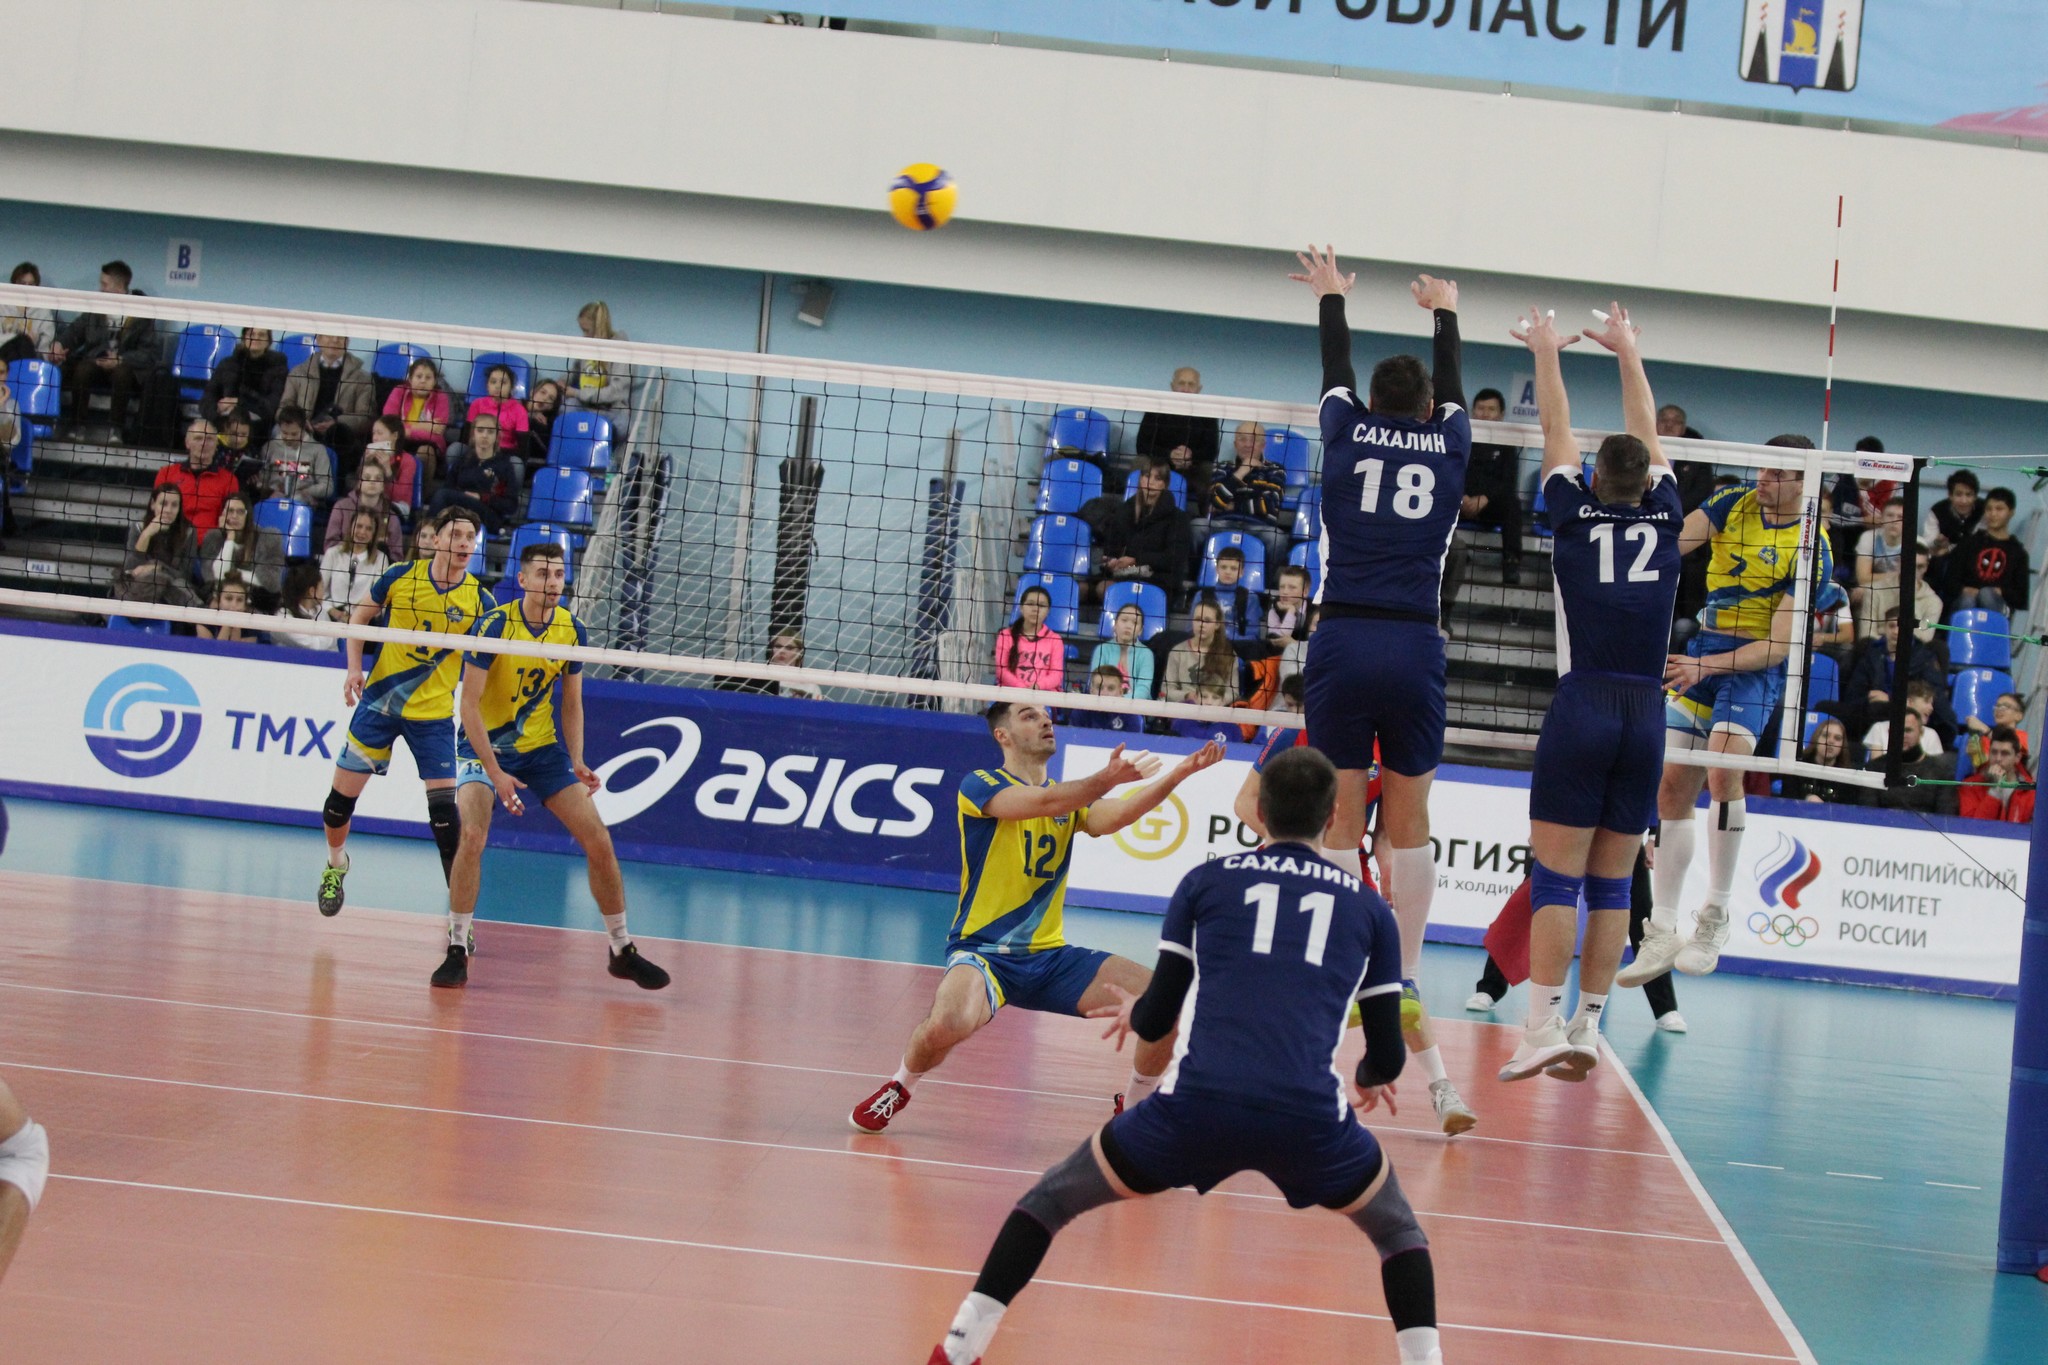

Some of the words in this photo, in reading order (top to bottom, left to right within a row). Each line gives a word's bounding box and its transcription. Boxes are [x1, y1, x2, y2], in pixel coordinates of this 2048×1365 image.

[1352, 423, 1447, 454] САХАЛИН
[1353, 457, 1436, 519] 18
[1589, 522, 1660, 583] 12
[511, 667, 546, 703] 13
[695, 748, 945, 838] asics
[1023, 829, 1057, 879] 12
[1223, 853, 1360, 893] САХАЛИН
[1843, 856, 2018, 891] ОЛИМПИЙСКИЙ
[1841, 888, 1942, 916] КОМИТЕТ
[1244, 882, 1335, 967] 11
[1839, 922, 1928, 948] РОССИИ
